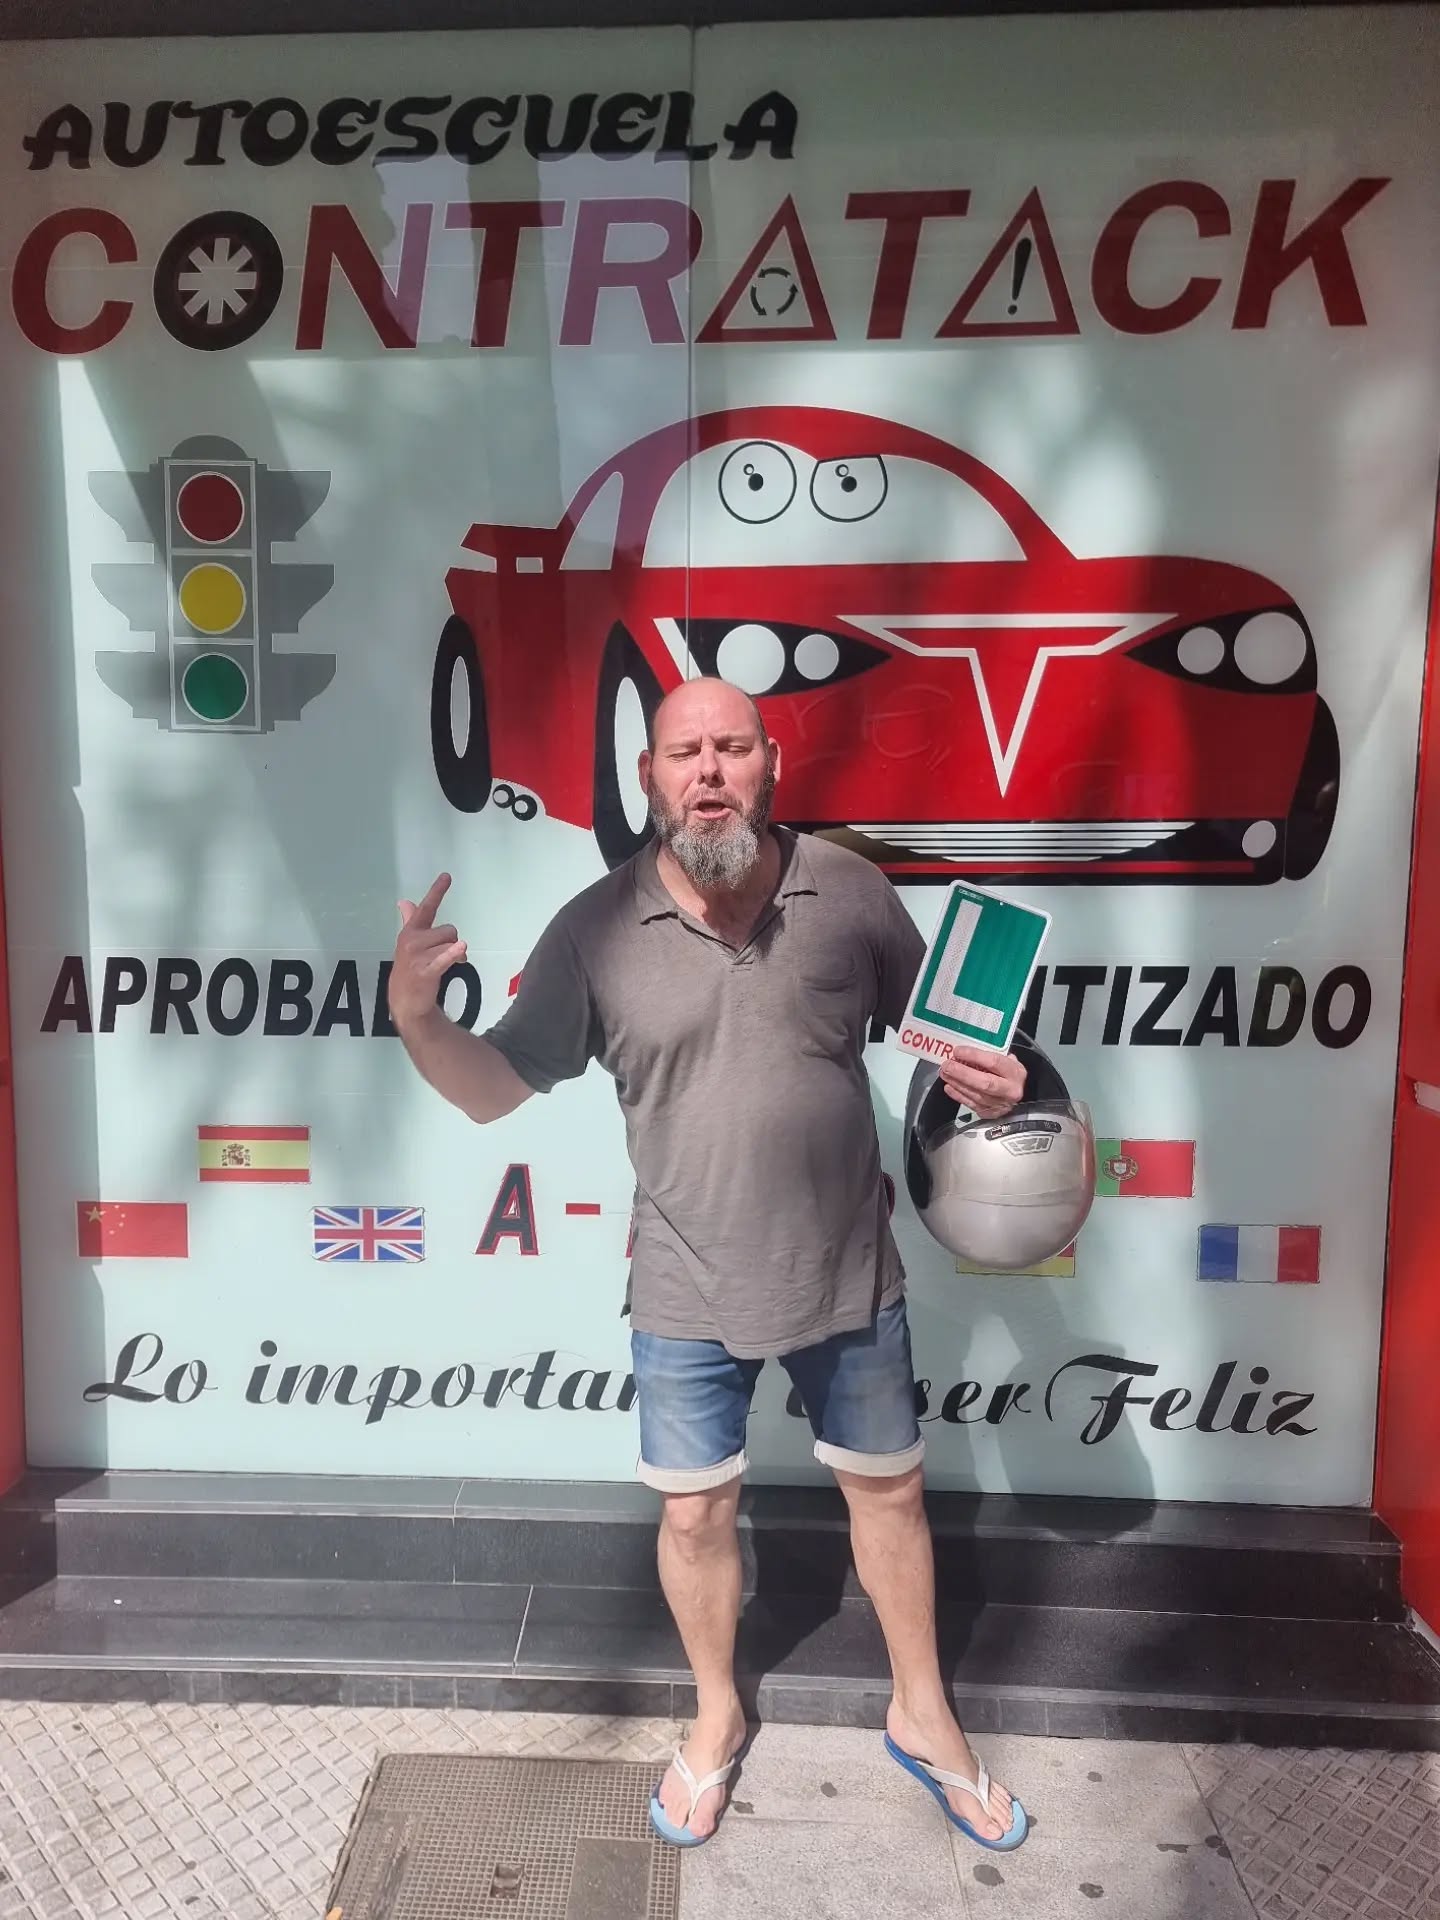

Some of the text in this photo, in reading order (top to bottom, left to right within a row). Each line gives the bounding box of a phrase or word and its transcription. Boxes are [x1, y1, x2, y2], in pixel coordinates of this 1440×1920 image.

[23, 91, 797, 170] AUTOESCUELA
[12, 178, 1392, 355] CONTRATACK
[926, 899, 1004, 1034] L
[901, 1028, 957, 1061] CONTR
[476, 1163, 539, 1256] A
[82, 1332, 218, 1404] Lo
[1045, 1353, 1318, 1446] Feliz
